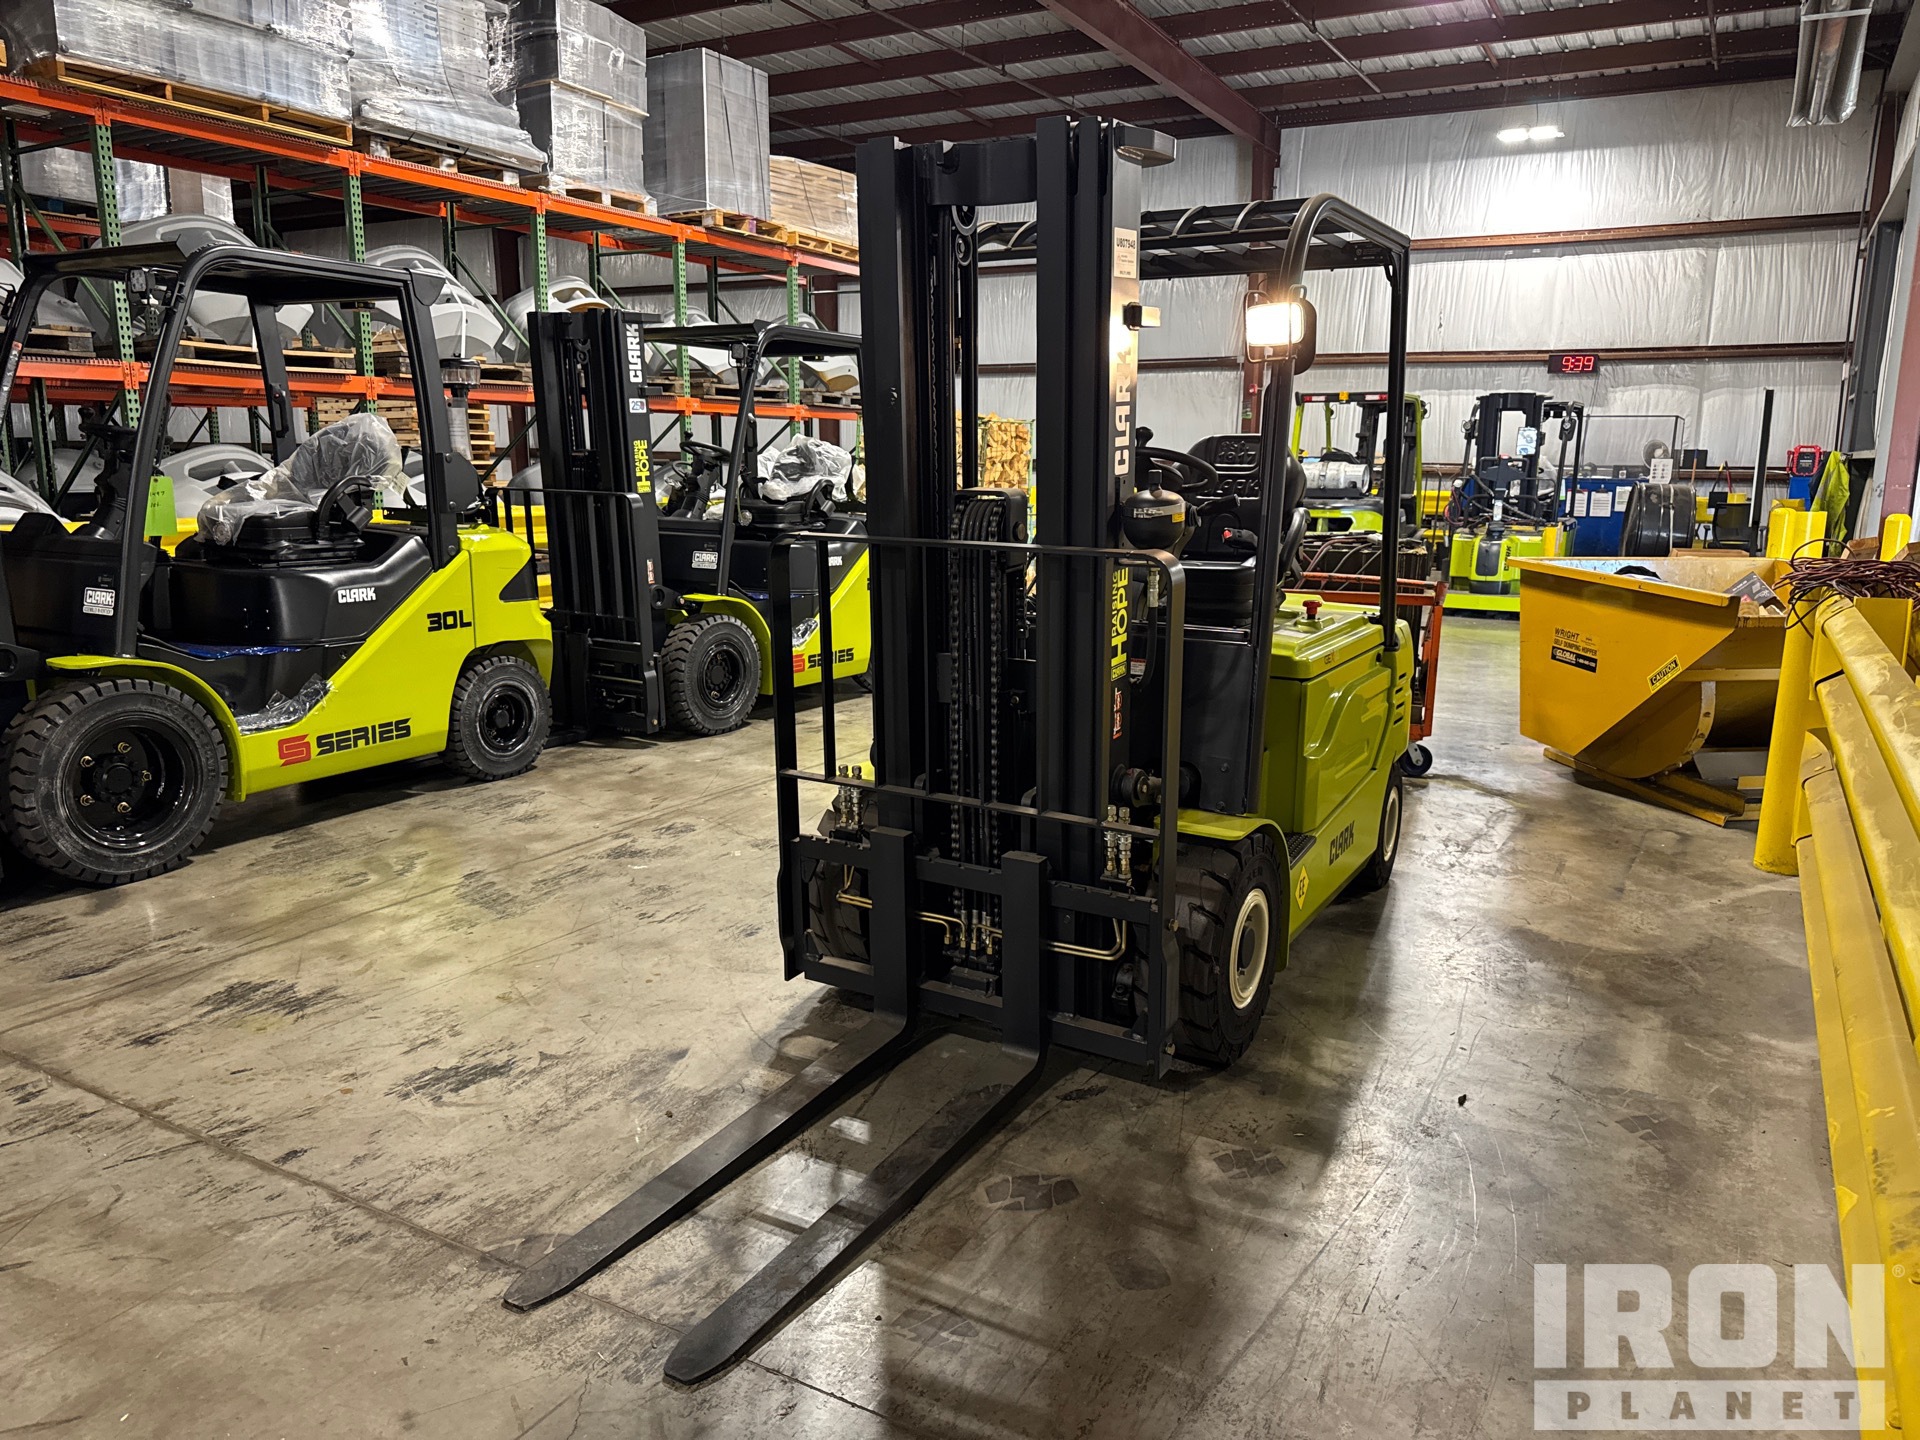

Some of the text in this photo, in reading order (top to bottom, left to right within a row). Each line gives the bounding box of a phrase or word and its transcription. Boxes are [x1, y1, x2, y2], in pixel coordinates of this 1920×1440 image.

[625, 323, 643, 383] CLARK
[1561, 356, 1595, 371] 9:39
[1114, 346, 1131, 475] CLARK
[637, 439, 650, 487] HOPE
[694, 553, 716, 563] CLARK
[86, 590, 112, 605] CLARK
[337, 587, 376, 603] CLARK
[427, 610, 472, 632] 30L
[1111, 567, 1128, 667] HOPE
[1555, 627, 1580, 641] WRIGHT
[808, 648, 854, 669] SEIES
[1652, 660, 1676, 684] CAUTION
[278, 717, 411, 767] S SERIES
[1329, 820, 1355, 867] CLARK
[1299, 876, 1306, 899] EE
